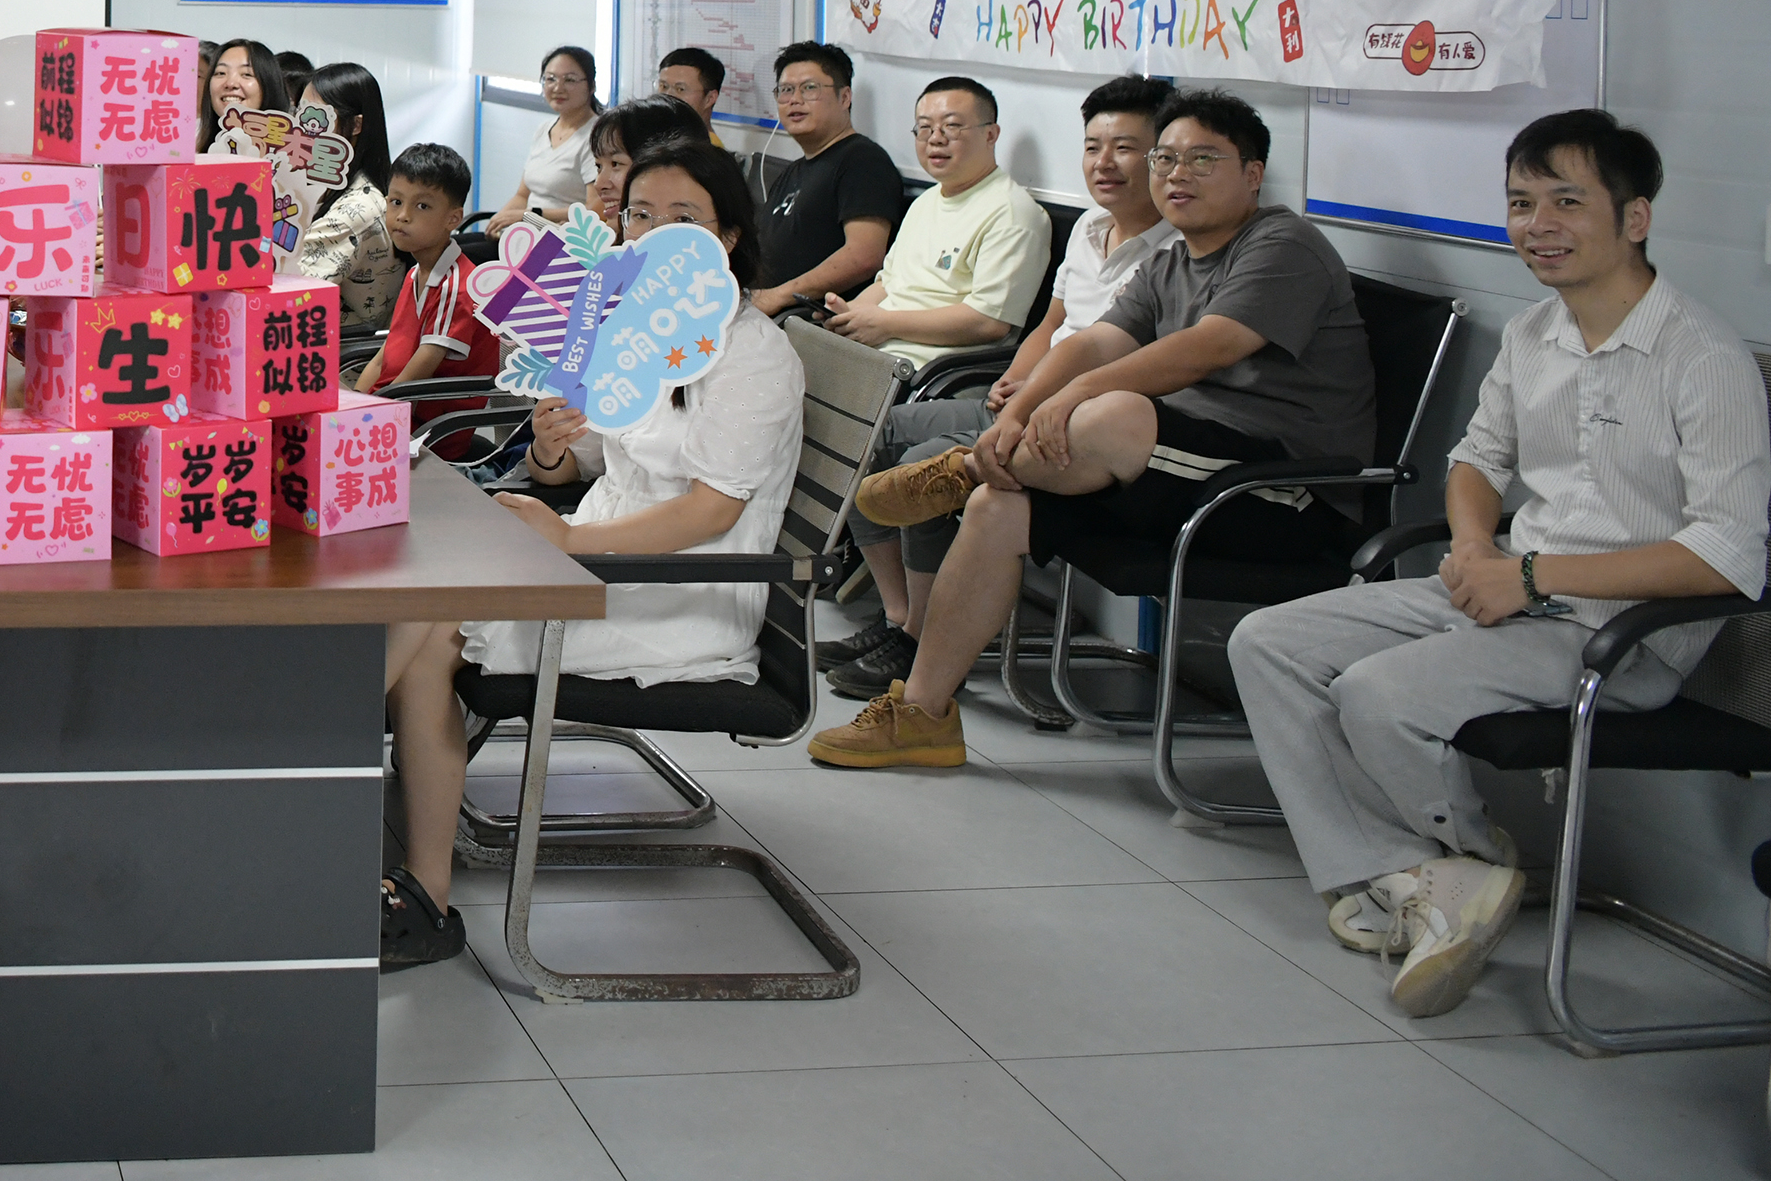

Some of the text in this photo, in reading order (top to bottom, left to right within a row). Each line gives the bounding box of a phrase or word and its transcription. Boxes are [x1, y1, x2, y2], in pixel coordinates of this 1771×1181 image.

[1368, 32, 1404, 50] 有钱花
[1438, 41, 1476, 61] 有人爱
[41, 51, 75, 94] 前程
[100, 56, 181, 95] 无忧
[39, 98, 74, 143] 似锦
[99, 100, 180, 144] 无虑
[115, 181, 151, 269] 日
[180, 182, 261, 271] 快
[33, 278, 63, 292] LUCK
[631, 240, 700, 305] HAPPY
[263, 305, 327, 351] 前程
[561, 270, 604, 373] BEST WISHES
[33, 311, 65, 401] 乐
[98, 322, 171, 405] 生
[262, 351, 327, 396] 似锦
[180, 440, 257, 488] 岁岁
[334, 422, 399, 467] 心想
[6, 452, 94, 494] 无忧
[334, 465, 398, 514] 事成
[5, 497, 94, 541] 无虑
[179, 488, 257, 534] 平安
